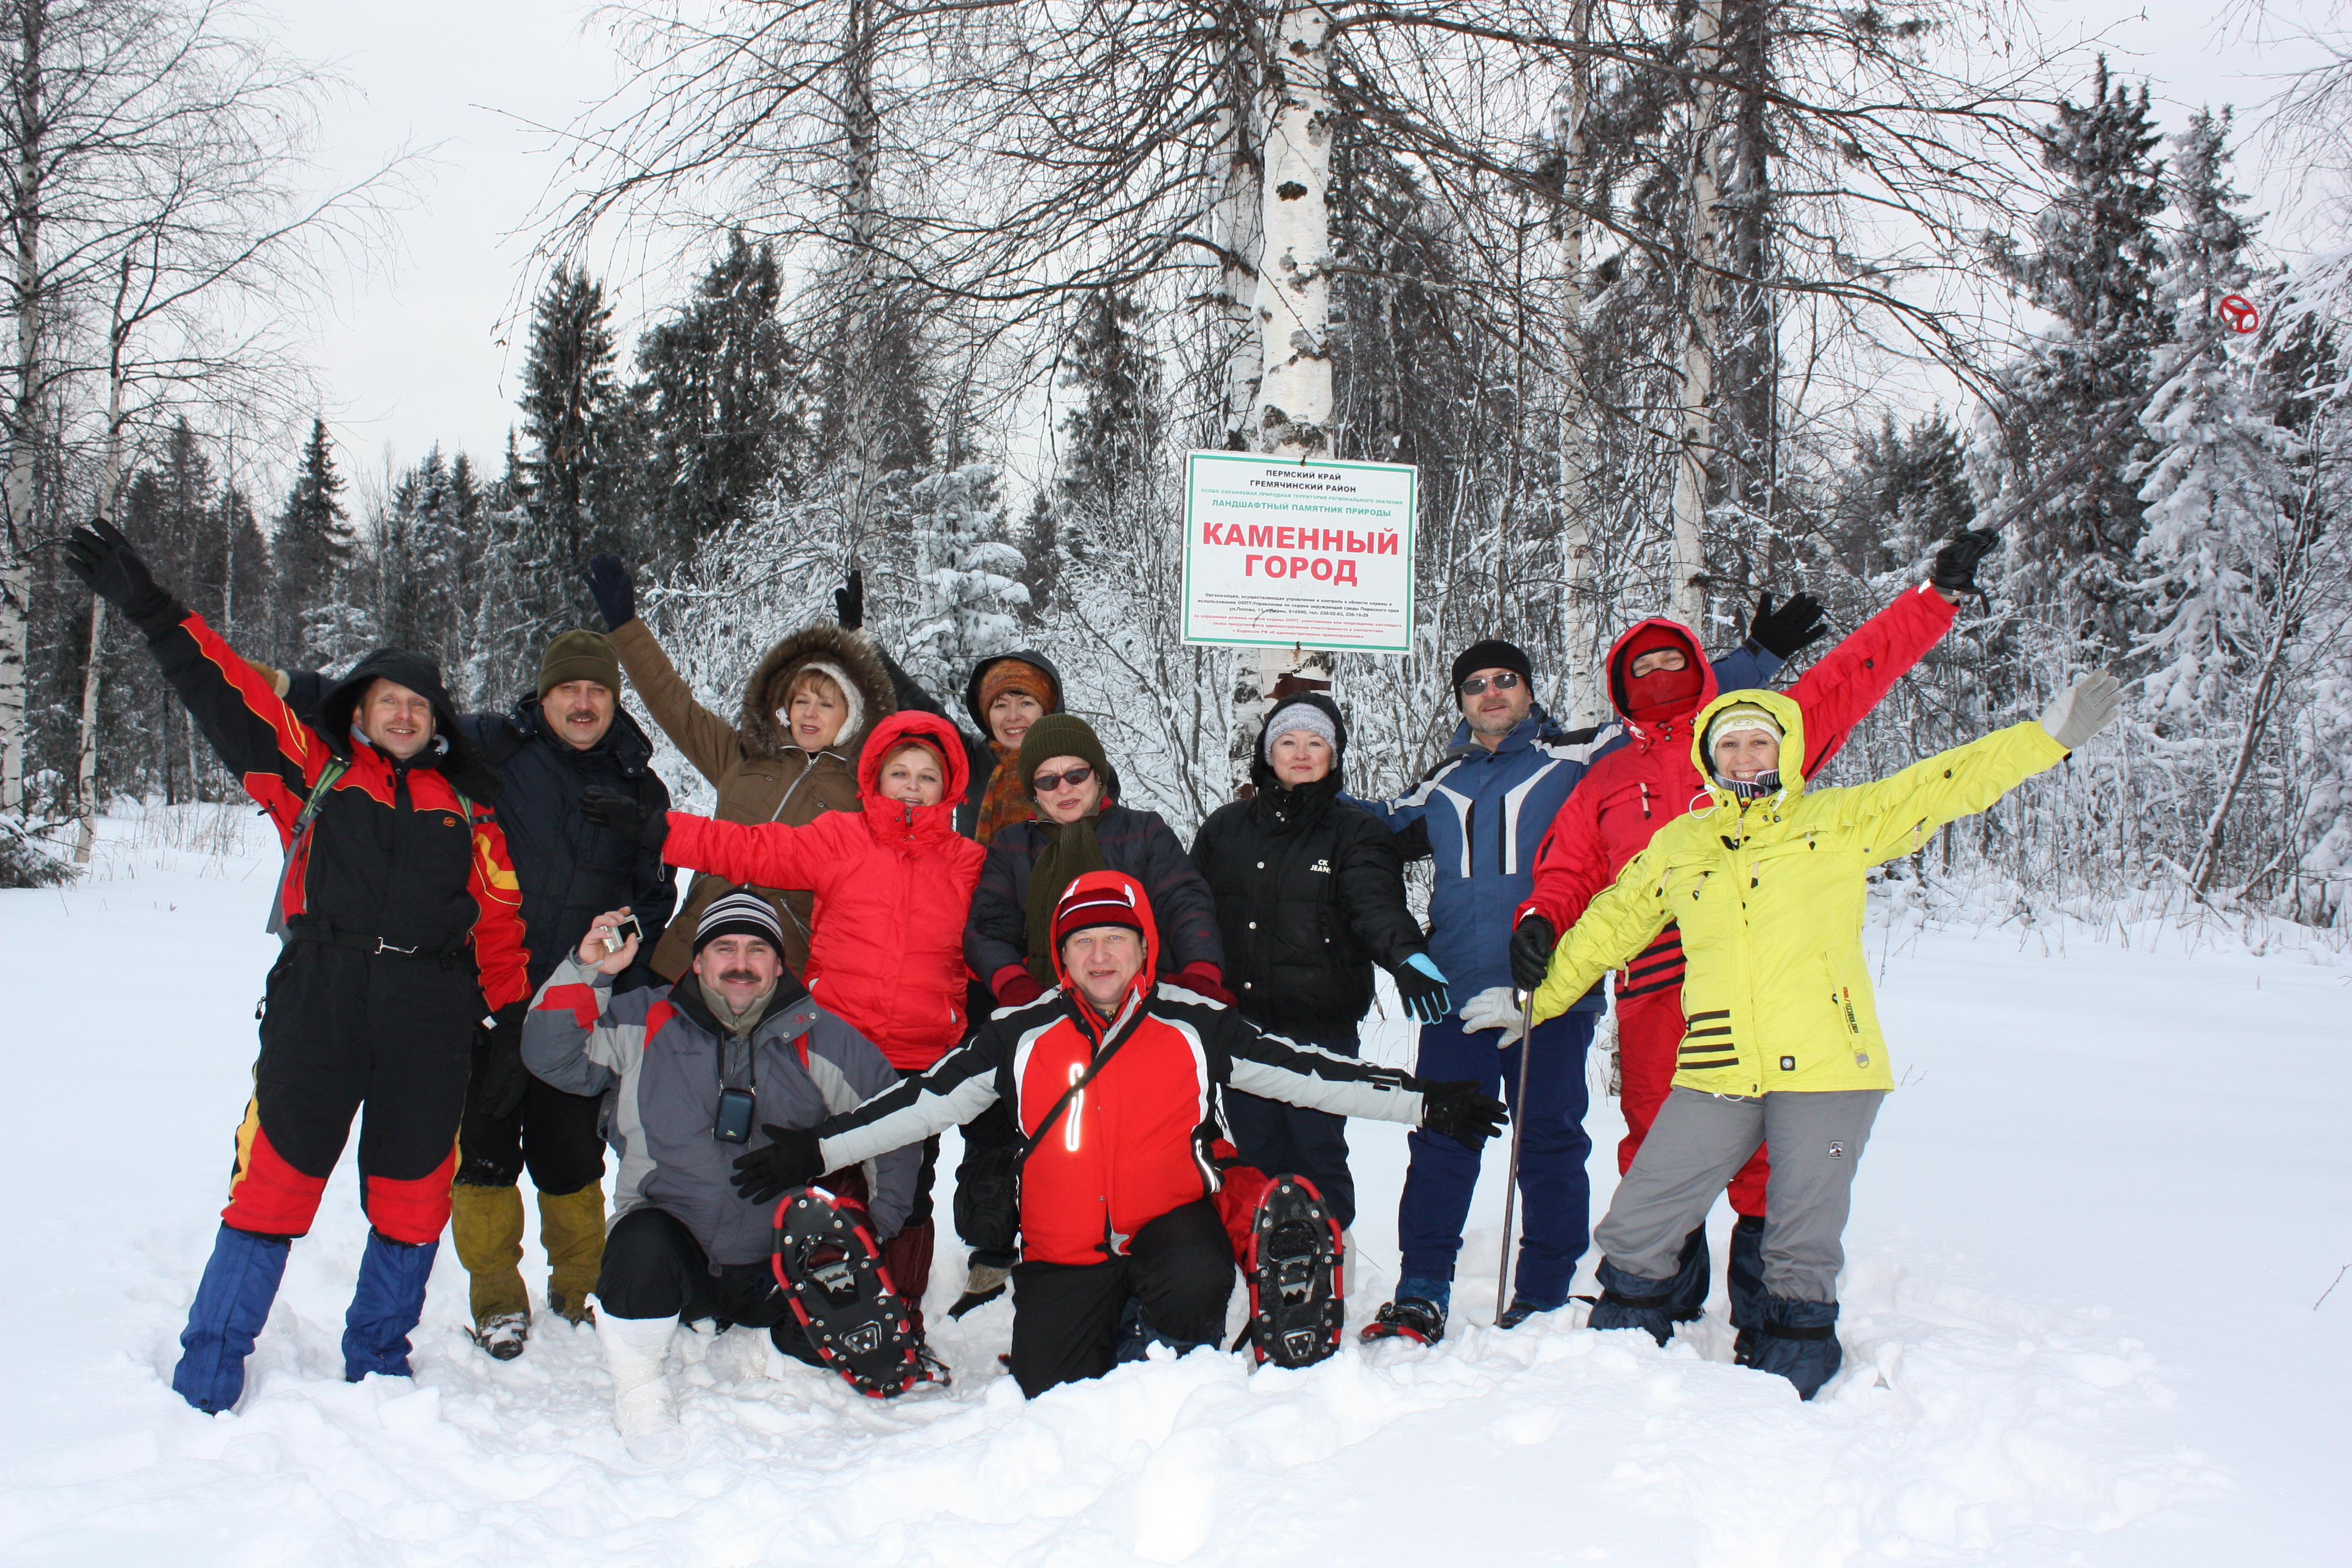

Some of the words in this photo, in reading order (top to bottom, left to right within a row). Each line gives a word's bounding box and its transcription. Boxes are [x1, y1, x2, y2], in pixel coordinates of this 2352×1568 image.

[1266, 470, 1315, 478] ПЕРМСКИЙ
[1250, 480, 1322, 491] ГРЕМЯЧИНСКИЙ
[1326, 484, 1355, 493] РАЙОН
[1212, 499, 1288, 510] ЛАНДШАФТНЫЙ
[1292, 504, 1342, 513] ПАМЯТНИК
[1346, 507, 1391, 516] ПРИРОДЫ
[1203, 522, 1398, 555] КАМЕННЫЙ
[1245, 554, 1357, 587] ГОРОД
